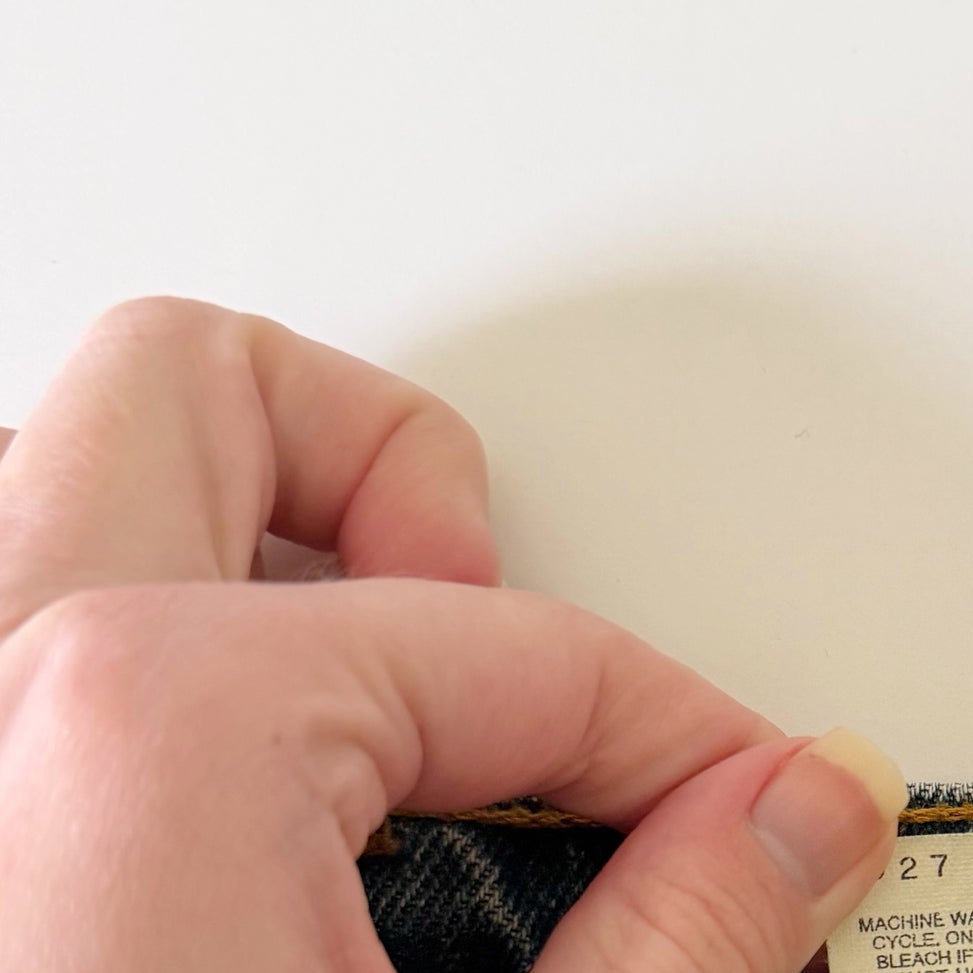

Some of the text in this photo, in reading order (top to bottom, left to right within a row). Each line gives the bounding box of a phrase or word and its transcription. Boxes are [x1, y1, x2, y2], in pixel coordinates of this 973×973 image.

[879, 854, 948, 880] 27
[859, 915, 943, 932] MACHINE
[877, 950, 951, 969] BLEACH
[957, 949, 972, 964] IF
